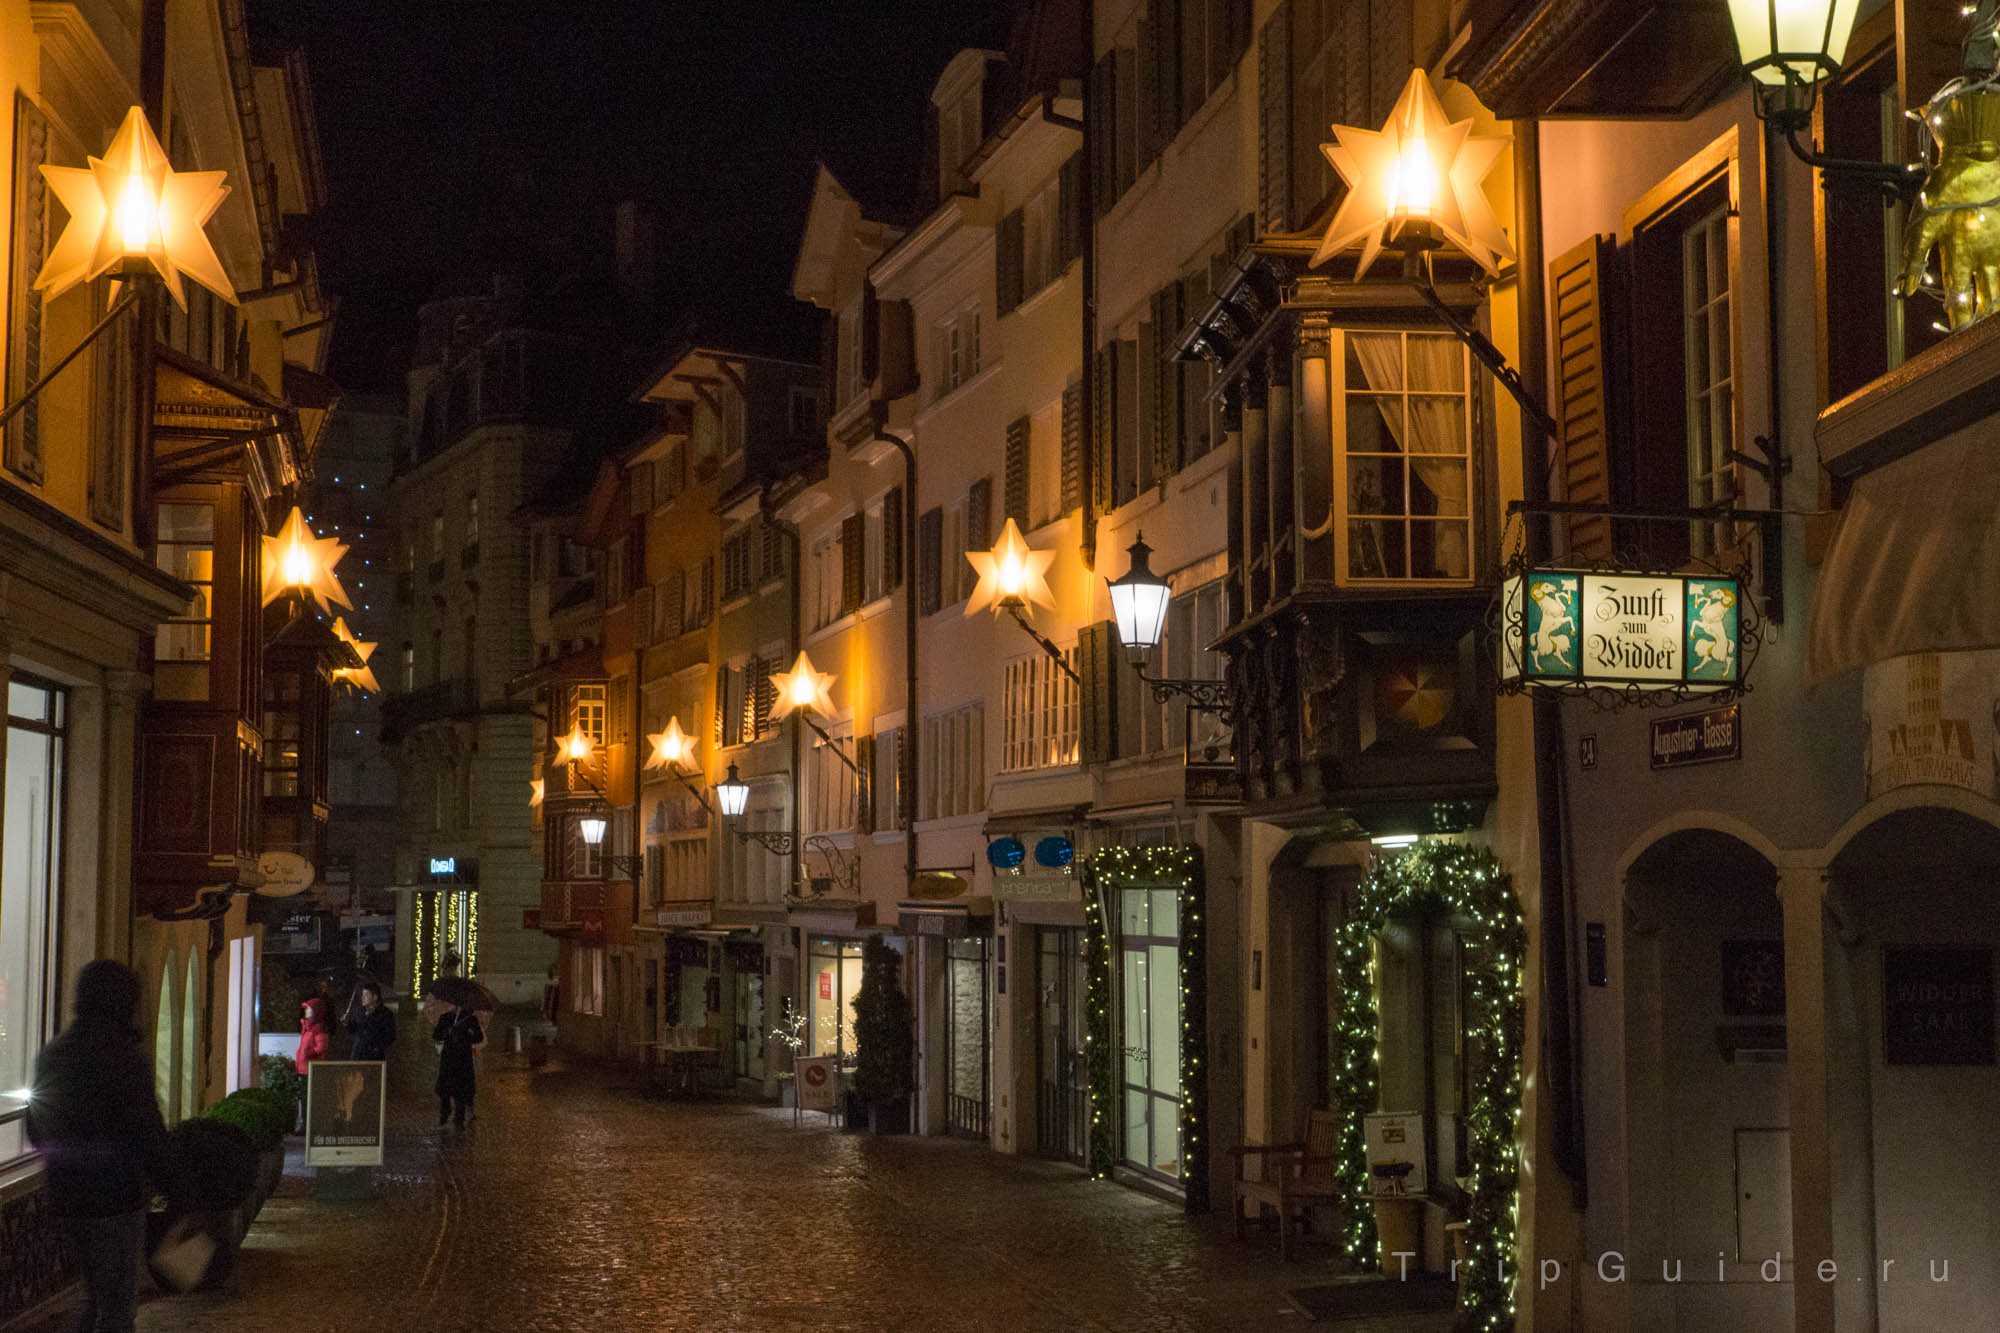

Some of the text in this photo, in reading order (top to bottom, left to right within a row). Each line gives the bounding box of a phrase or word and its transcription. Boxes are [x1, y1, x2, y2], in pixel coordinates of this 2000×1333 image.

[1594, 585, 1674, 623] Zunft
[1618, 622, 1647, 634] zum
[1588, 634, 1677, 670] Widder
